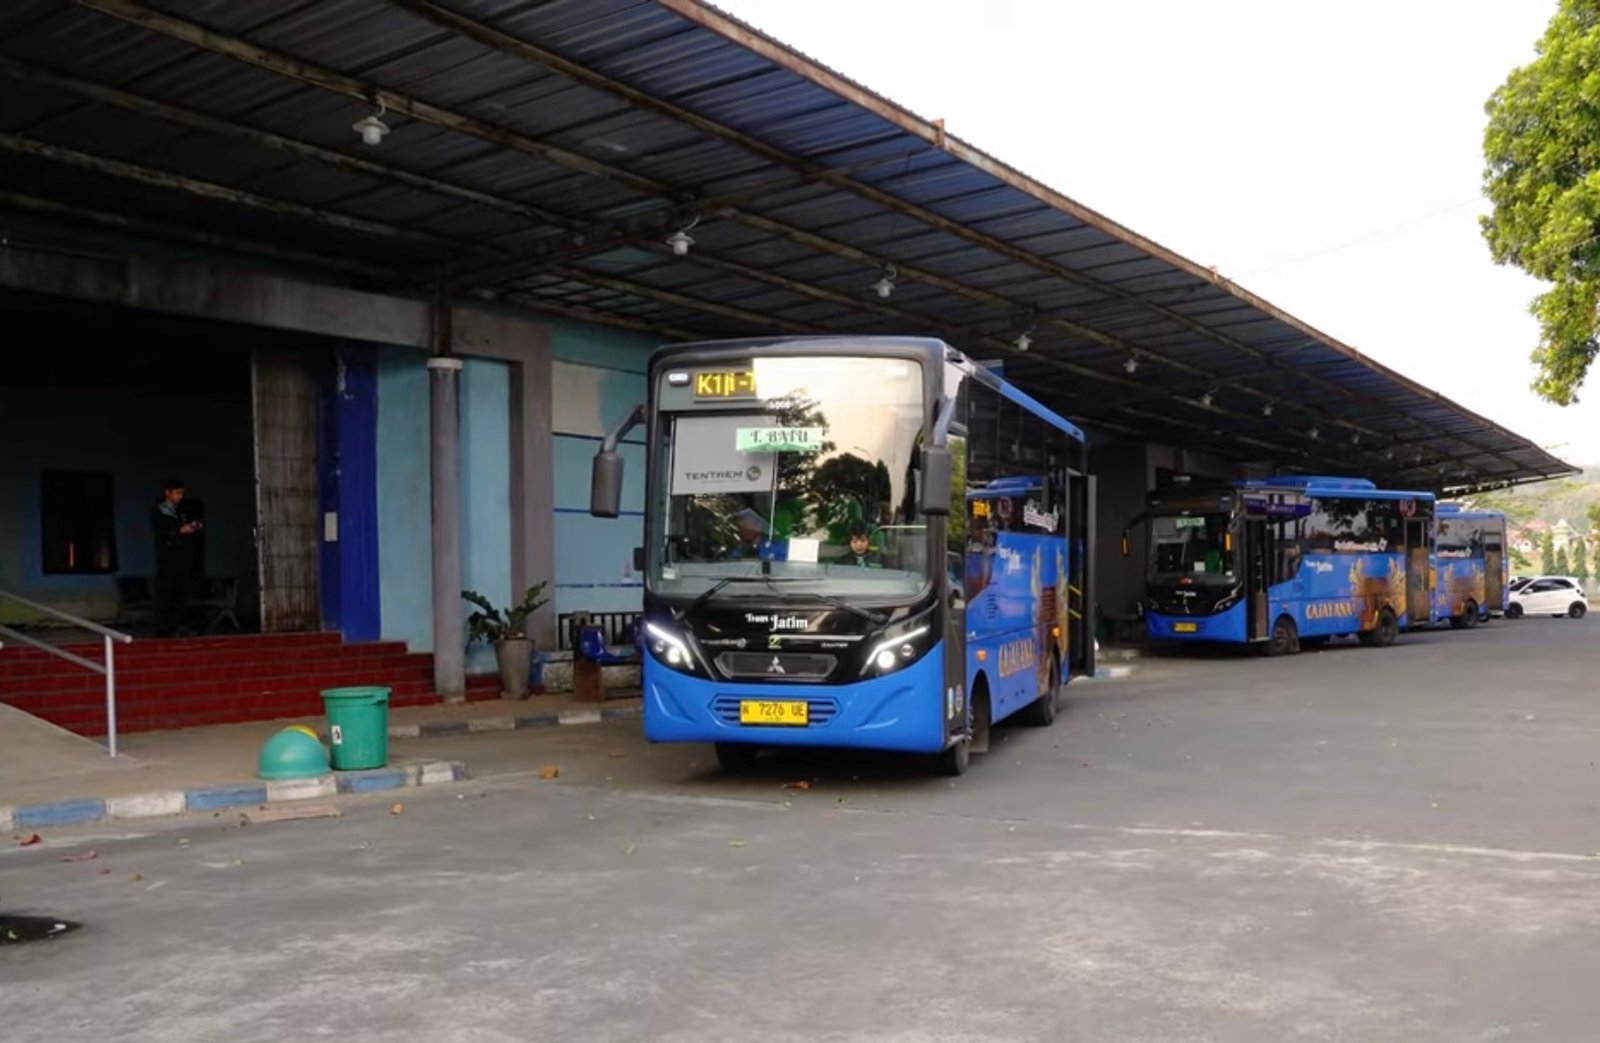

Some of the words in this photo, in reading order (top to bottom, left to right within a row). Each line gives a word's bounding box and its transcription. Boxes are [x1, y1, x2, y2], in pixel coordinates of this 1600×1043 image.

[765, 430, 808, 443] BATU
[685, 470, 743, 481] TENTREM
[768, 613, 808, 632] Jatim
